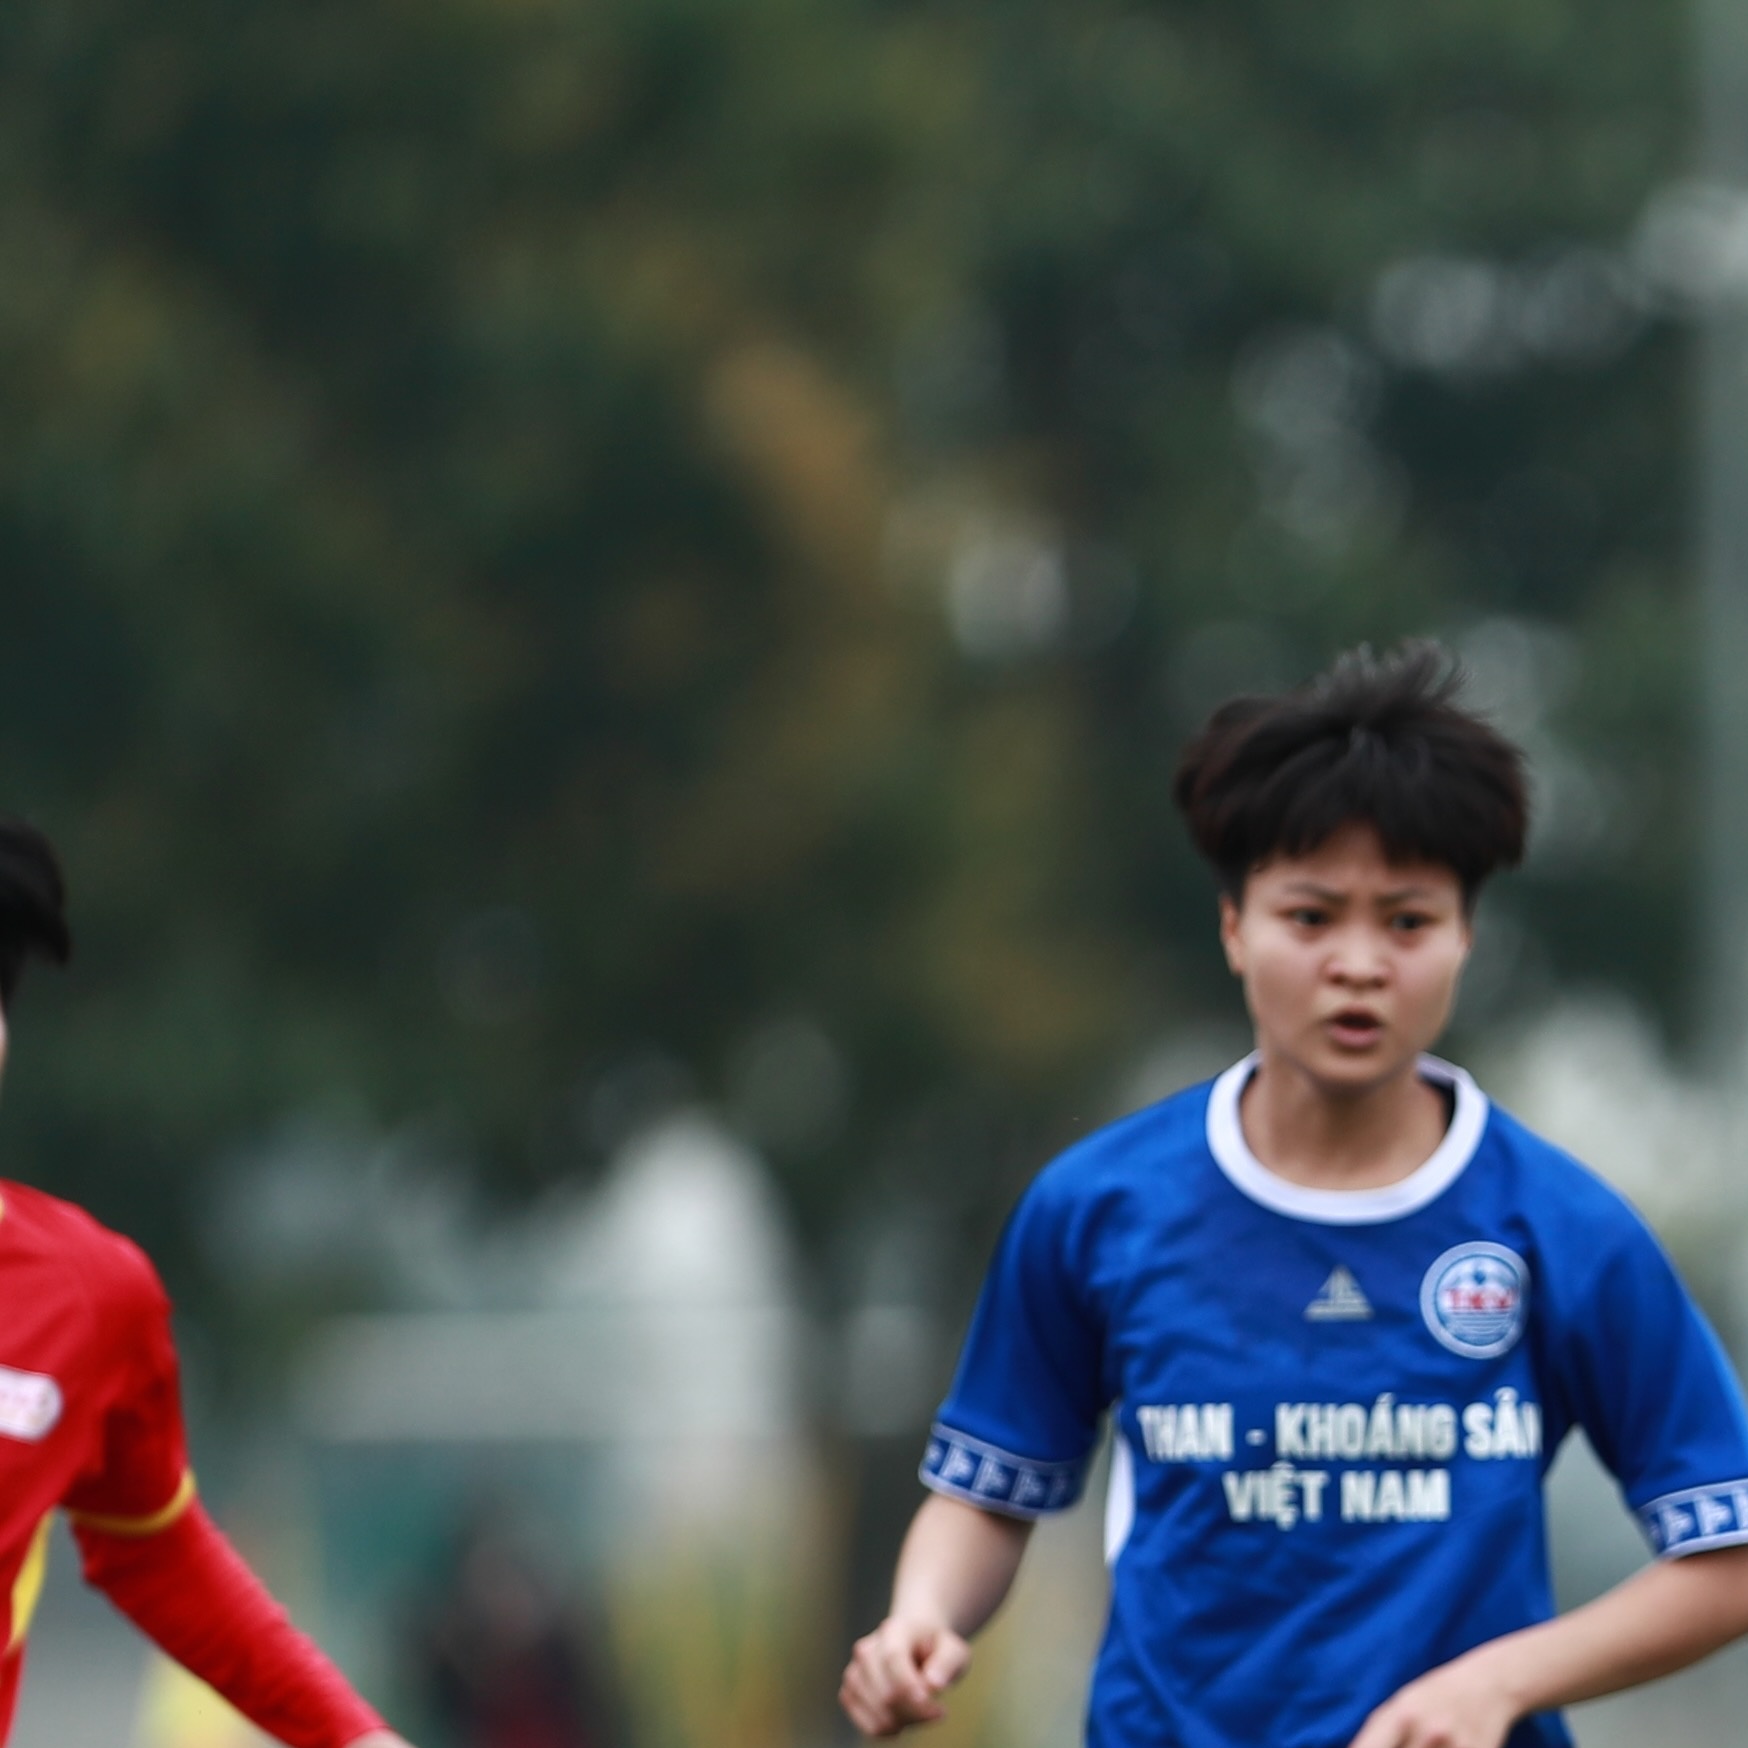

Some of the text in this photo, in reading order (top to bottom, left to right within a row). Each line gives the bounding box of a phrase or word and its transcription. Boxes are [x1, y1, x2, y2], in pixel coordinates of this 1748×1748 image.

[1274, 1393, 1459, 1460] KHOÁNG
[1222, 1459, 1453, 1531] VIỆT NAM
